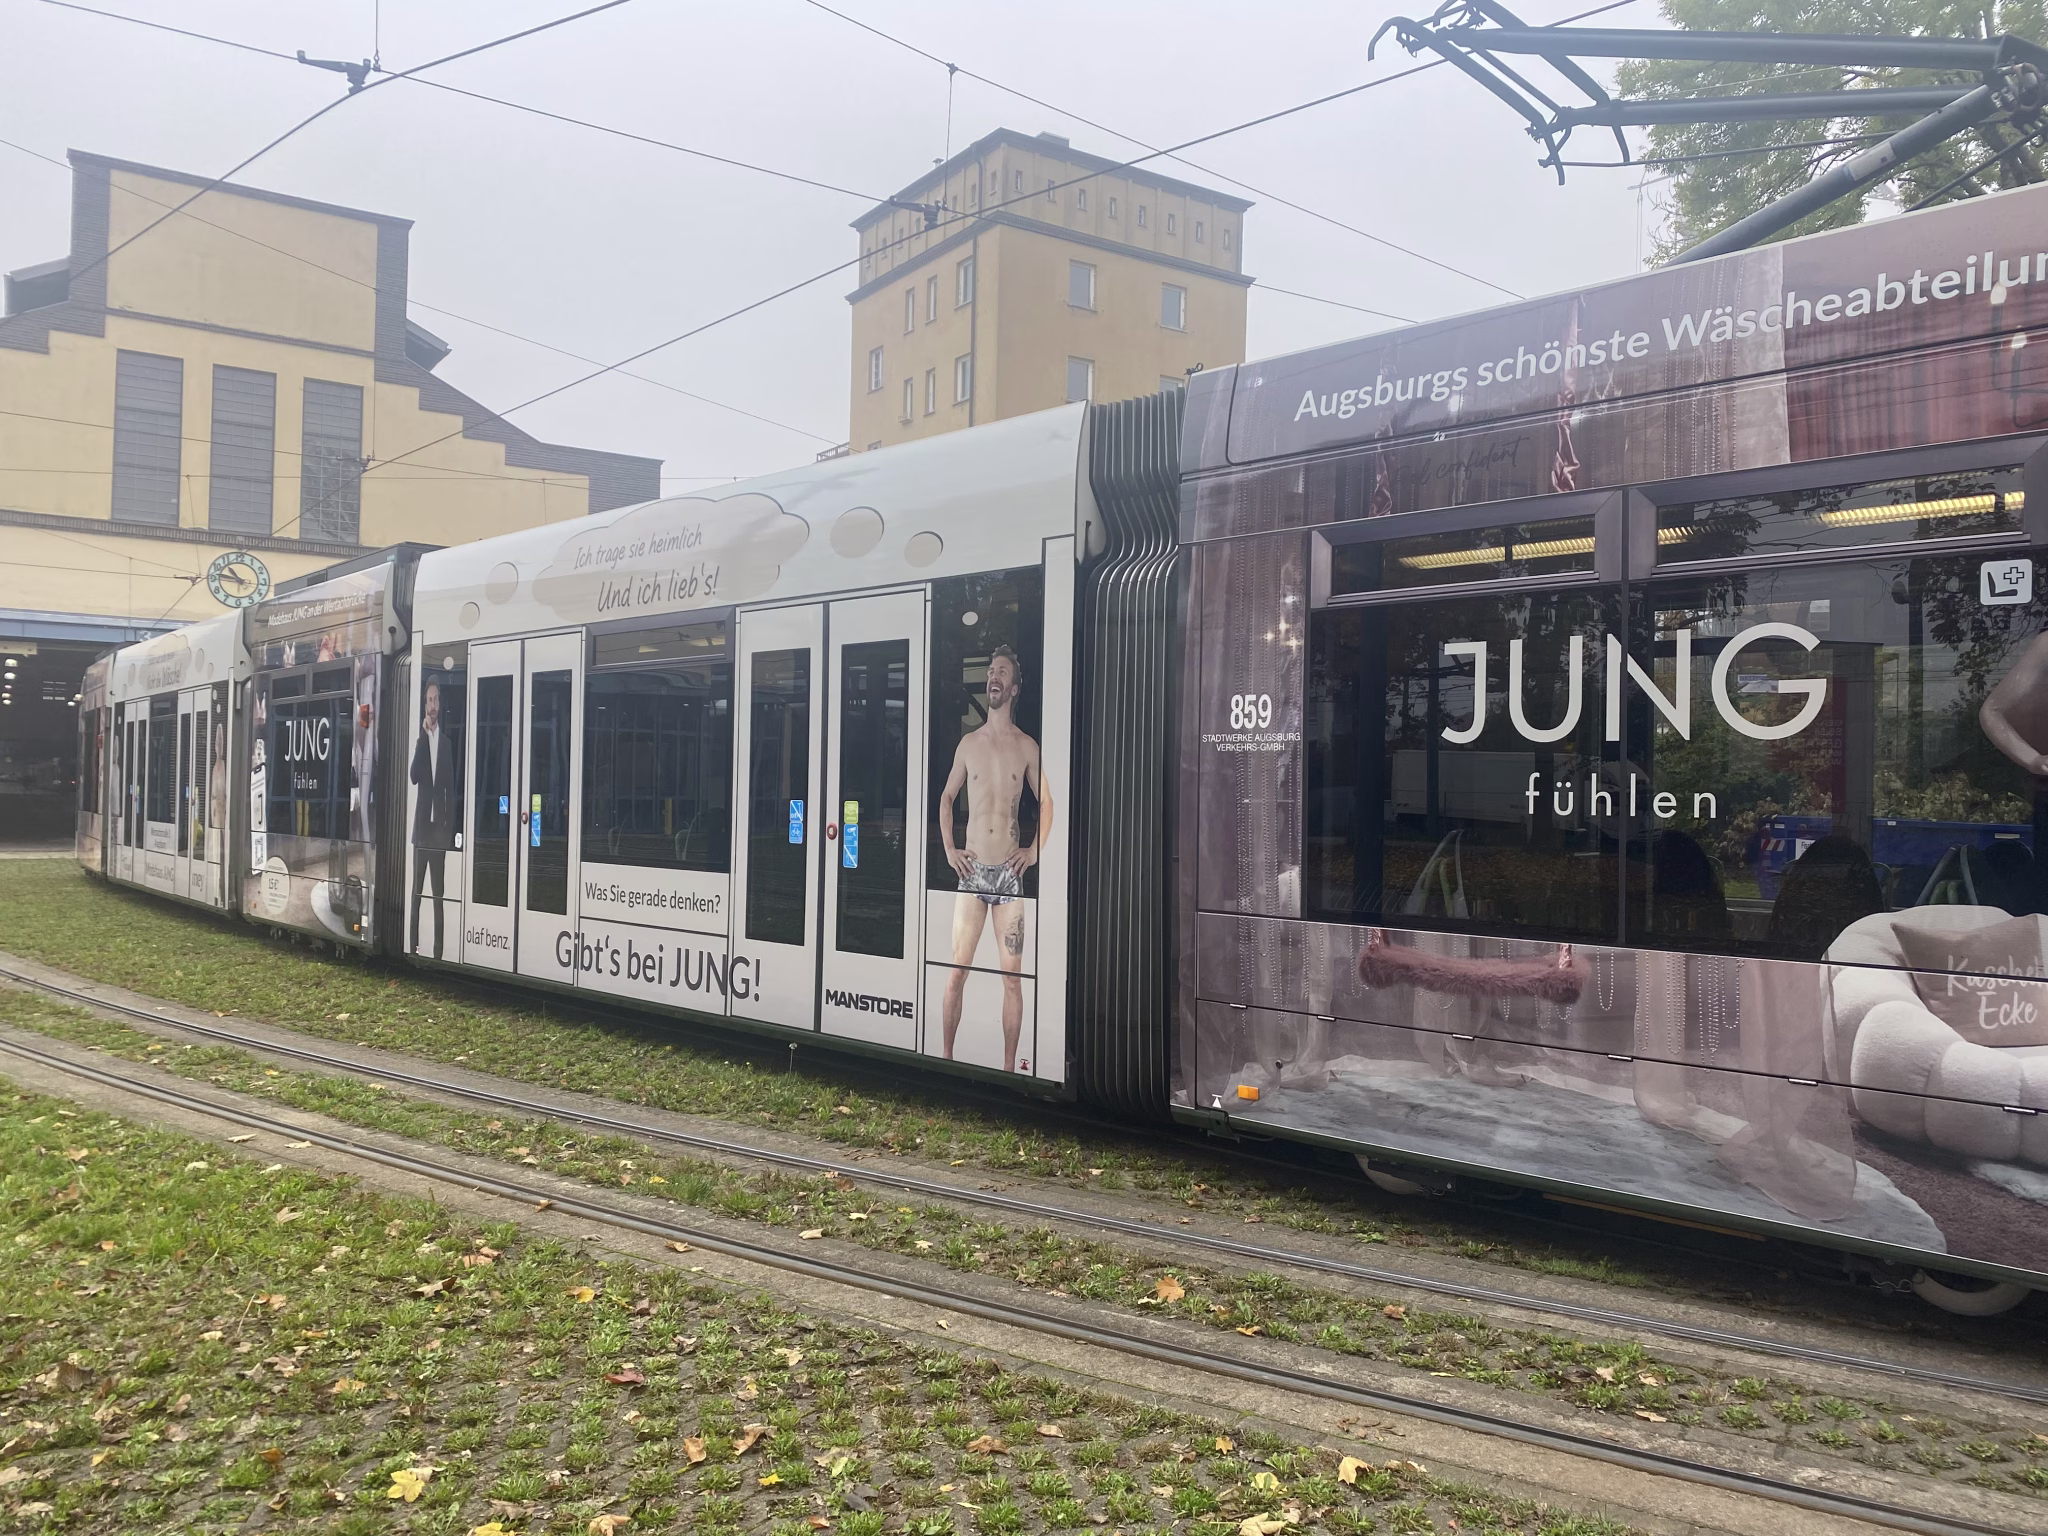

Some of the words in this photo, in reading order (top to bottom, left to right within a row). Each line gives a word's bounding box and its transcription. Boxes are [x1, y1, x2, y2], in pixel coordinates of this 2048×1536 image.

[1294, 366, 1468, 422] Augsburgs
[1476, 329, 1651, 386] schönste
[573, 545, 592, 570] Ich
[595, 543, 625, 569] trage
[628, 538, 645, 558] sie
[649, 523, 702, 554] heimlich
[597, 576, 634, 612] Und
[637, 571, 661, 605] ich
[667, 562, 720, 602] lieb's!
[268, 613, 293, 627] Modehaus
[292, 605, 308, 621] JUNG
[307, 607, 314, 617] an
[314, 603, 323, 616] der
[323, 593, 366, 613] Wertachbrücke
[139, 630, 152, 641] 3
[1440, 622, 1827, 744] JUNG
[1230, 694, 1272, 729] 859
[284, 717, 330, 761] JUNG
[1202, 734, 1253, 743] STADTWERKE
[1254, 732, 1301, 742] AUGSBURG
[1216, 743, 1285, 752] VERKEHRS-GMBH
[294, 772, 317, 789] fühlen
[1525, 772, 1717, 819] fühlen
[585, 881, 607, 901] Was
[609, 884, 626, 904] Sie
[628, 888, 667, 909] gerade
[669, 889, 721, 914] denken?
[466, 926, 485, 945] olaf
[555, 930, 621, 977] Gibt's
[627, 939, 664, 985] bei
[670, 947, 761, 1002] JUNG!
[825, 988, 914, 1019] MANSTORE
[1976, 990, 2038, 1030] Ecke
